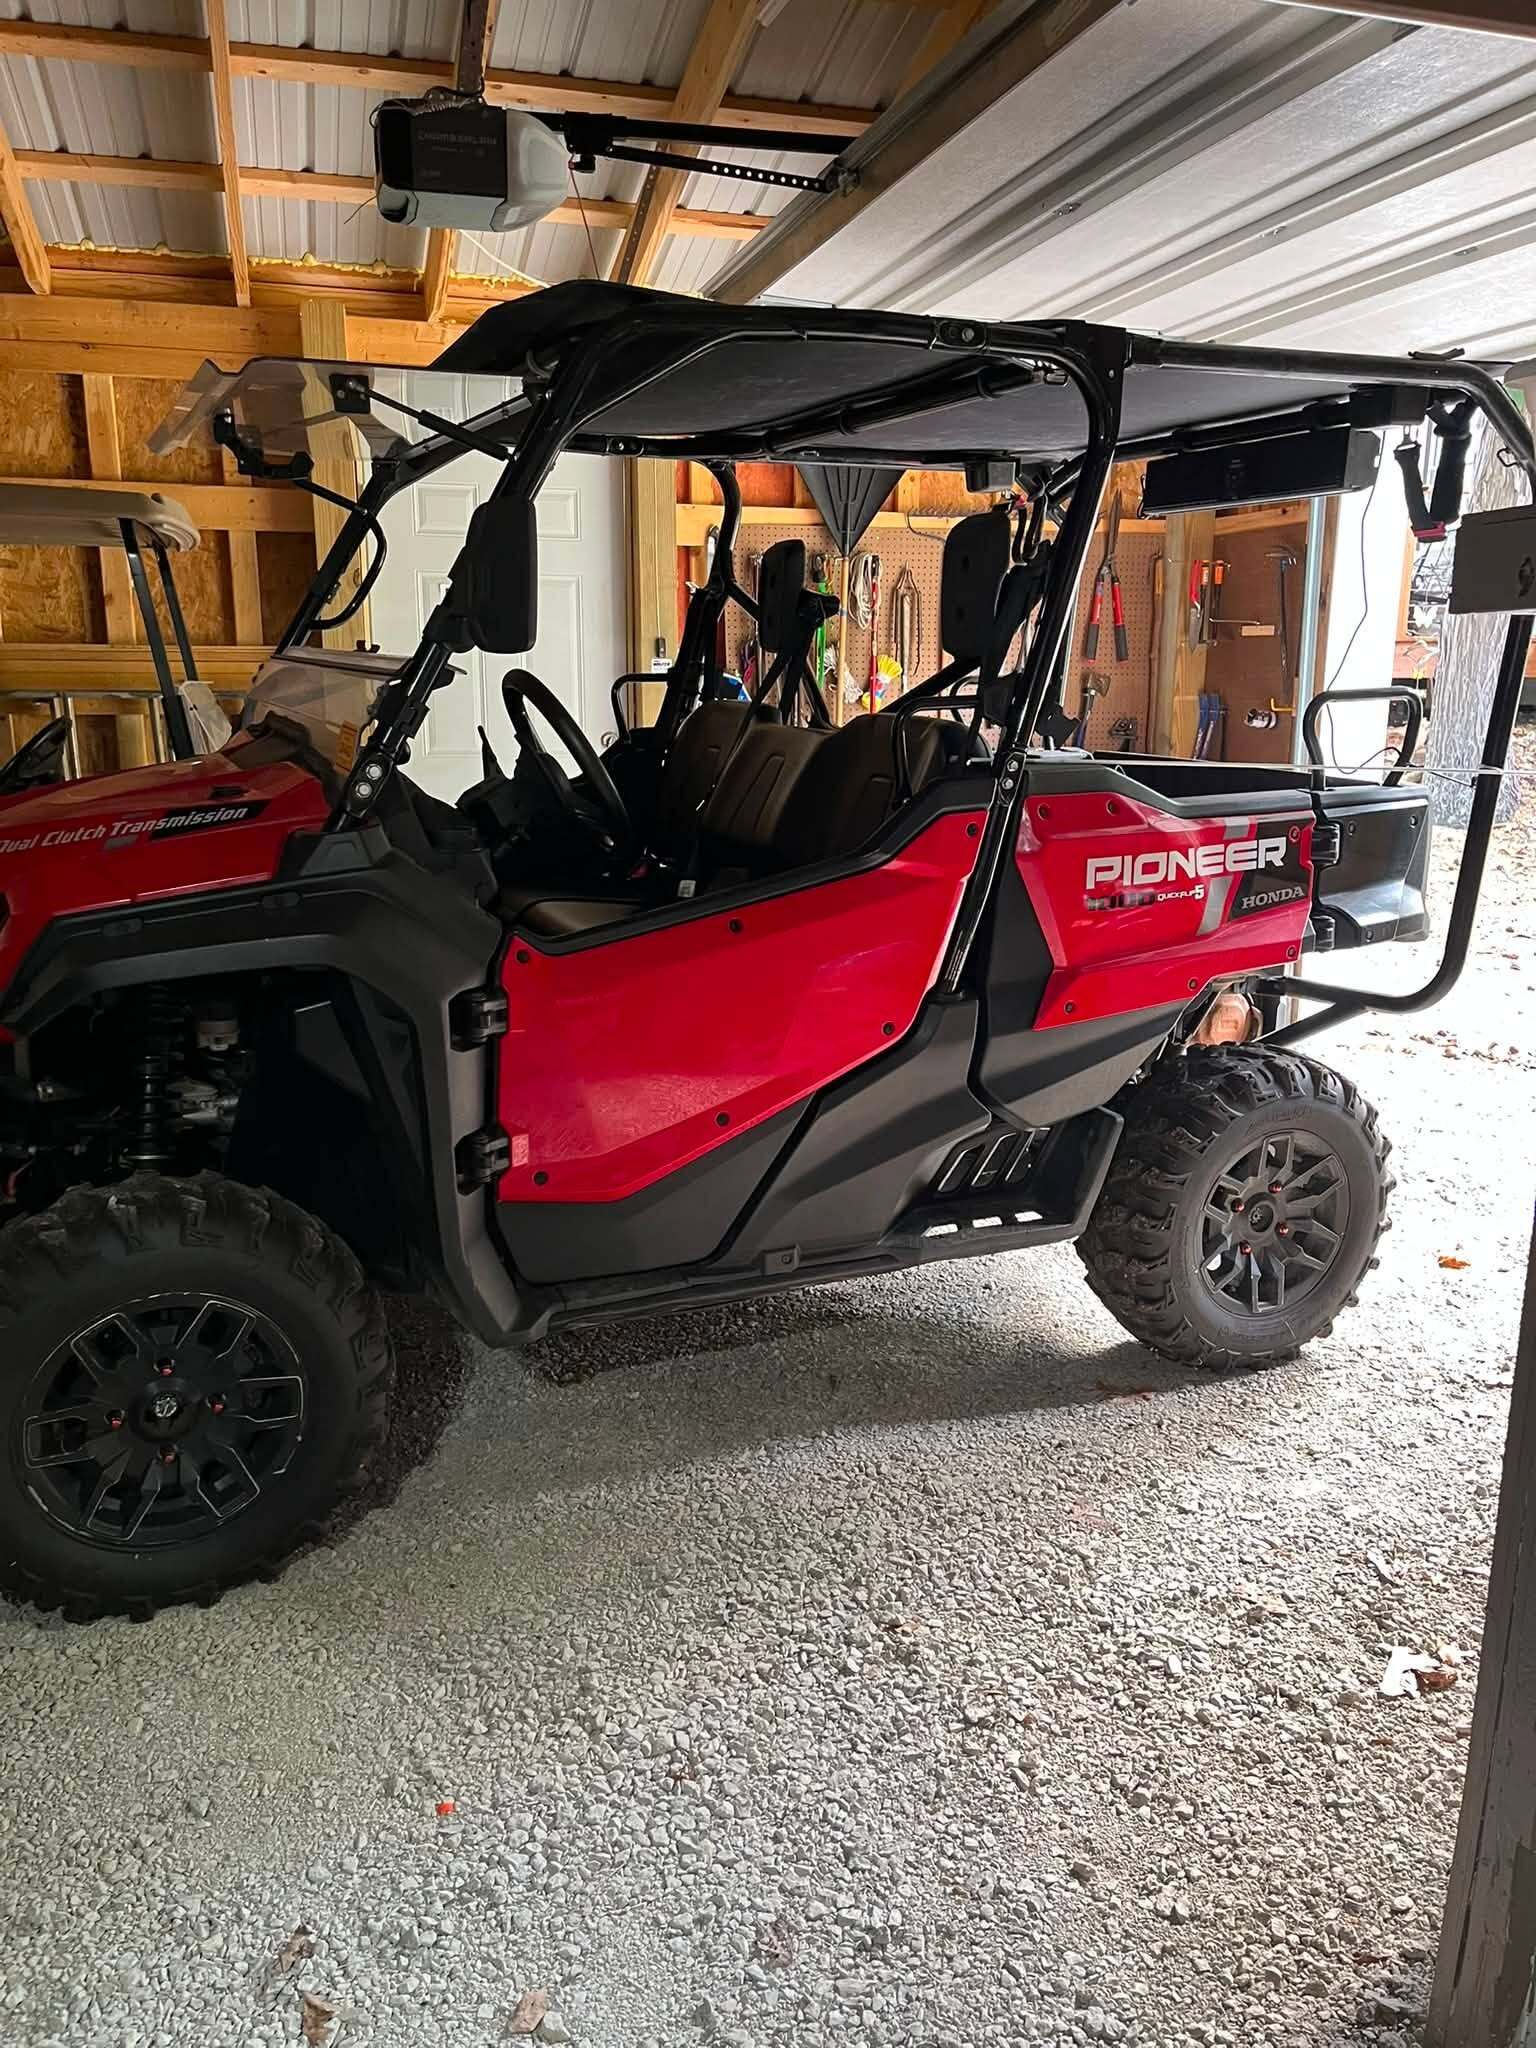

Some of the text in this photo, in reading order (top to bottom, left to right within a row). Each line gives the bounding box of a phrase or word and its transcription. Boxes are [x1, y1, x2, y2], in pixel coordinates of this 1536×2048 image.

[41, 824, 106, 846] Clutch
[110, 807, 248, 836] Transmission
[1086, 836, 1287, 890] PIONEER
[1241, 886, 1305, 910] HONDA
